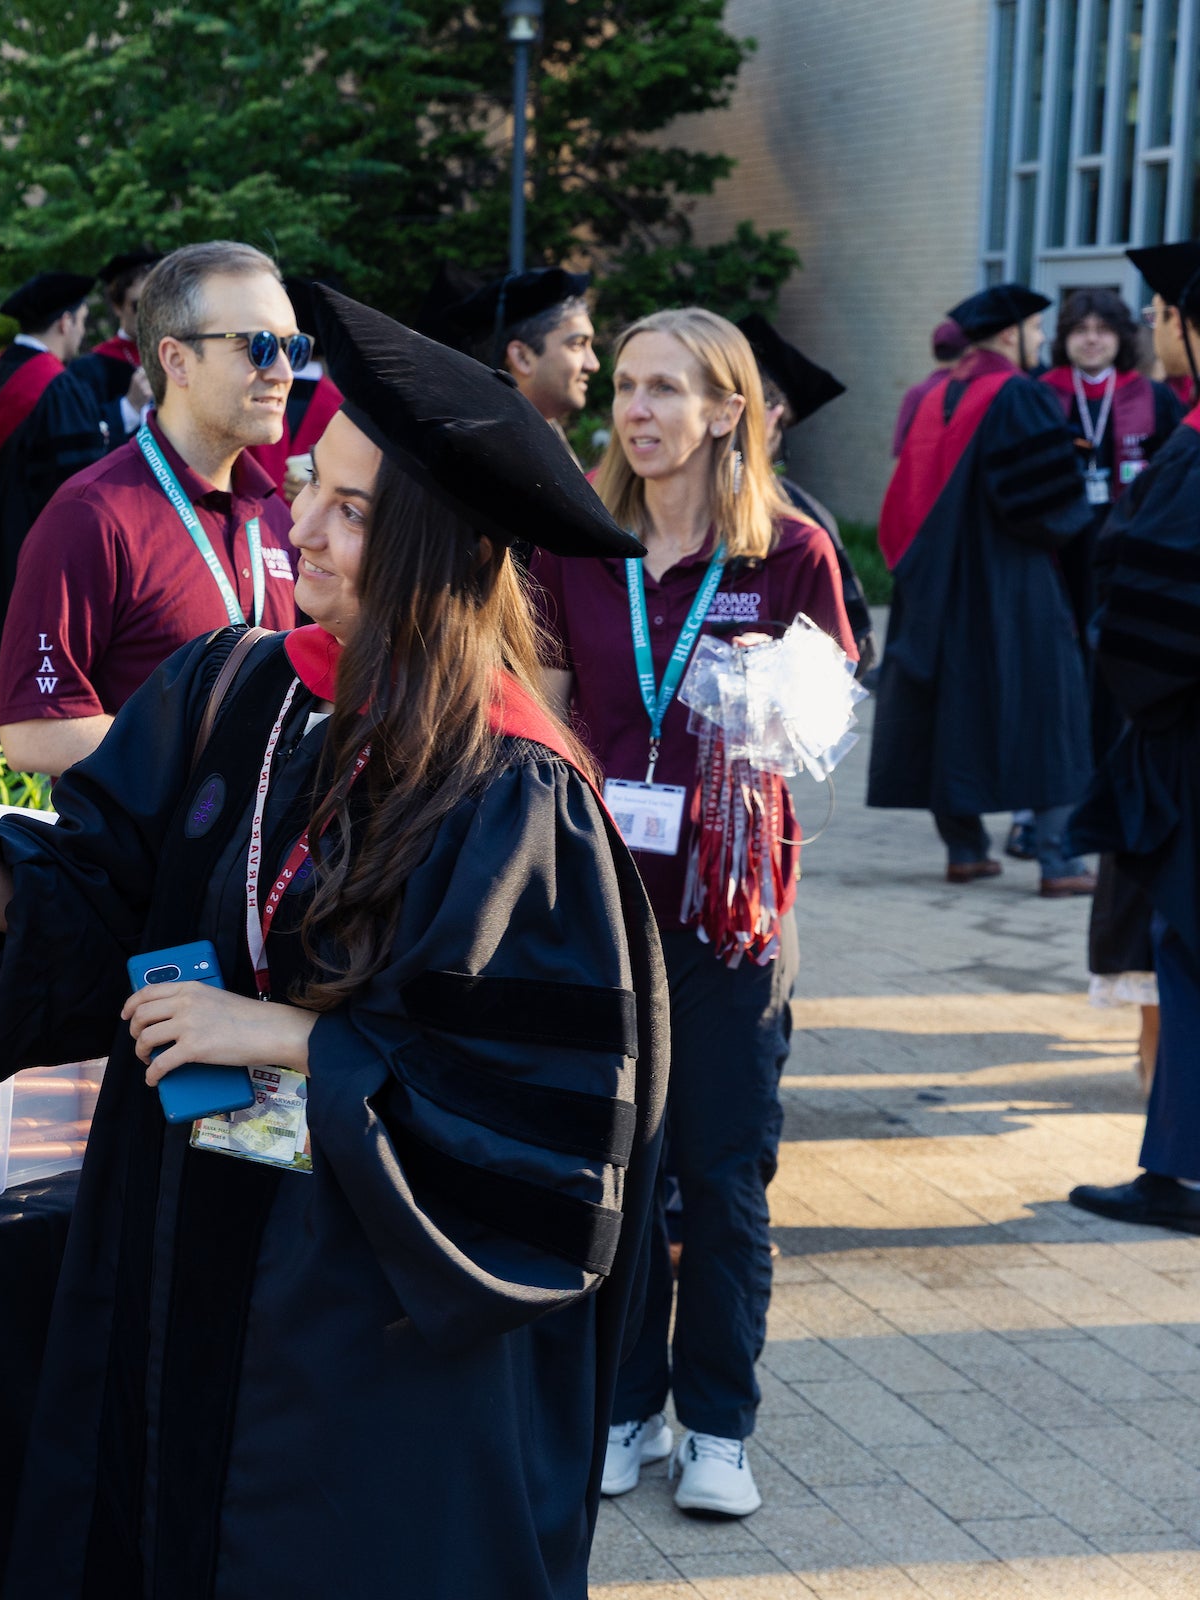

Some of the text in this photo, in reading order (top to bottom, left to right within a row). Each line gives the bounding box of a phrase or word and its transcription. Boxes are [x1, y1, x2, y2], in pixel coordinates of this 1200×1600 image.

[35, 633, 59, 694] LAW
[672, 632, 695, 663] HLS
[265, 868, 294, 915] 2026
